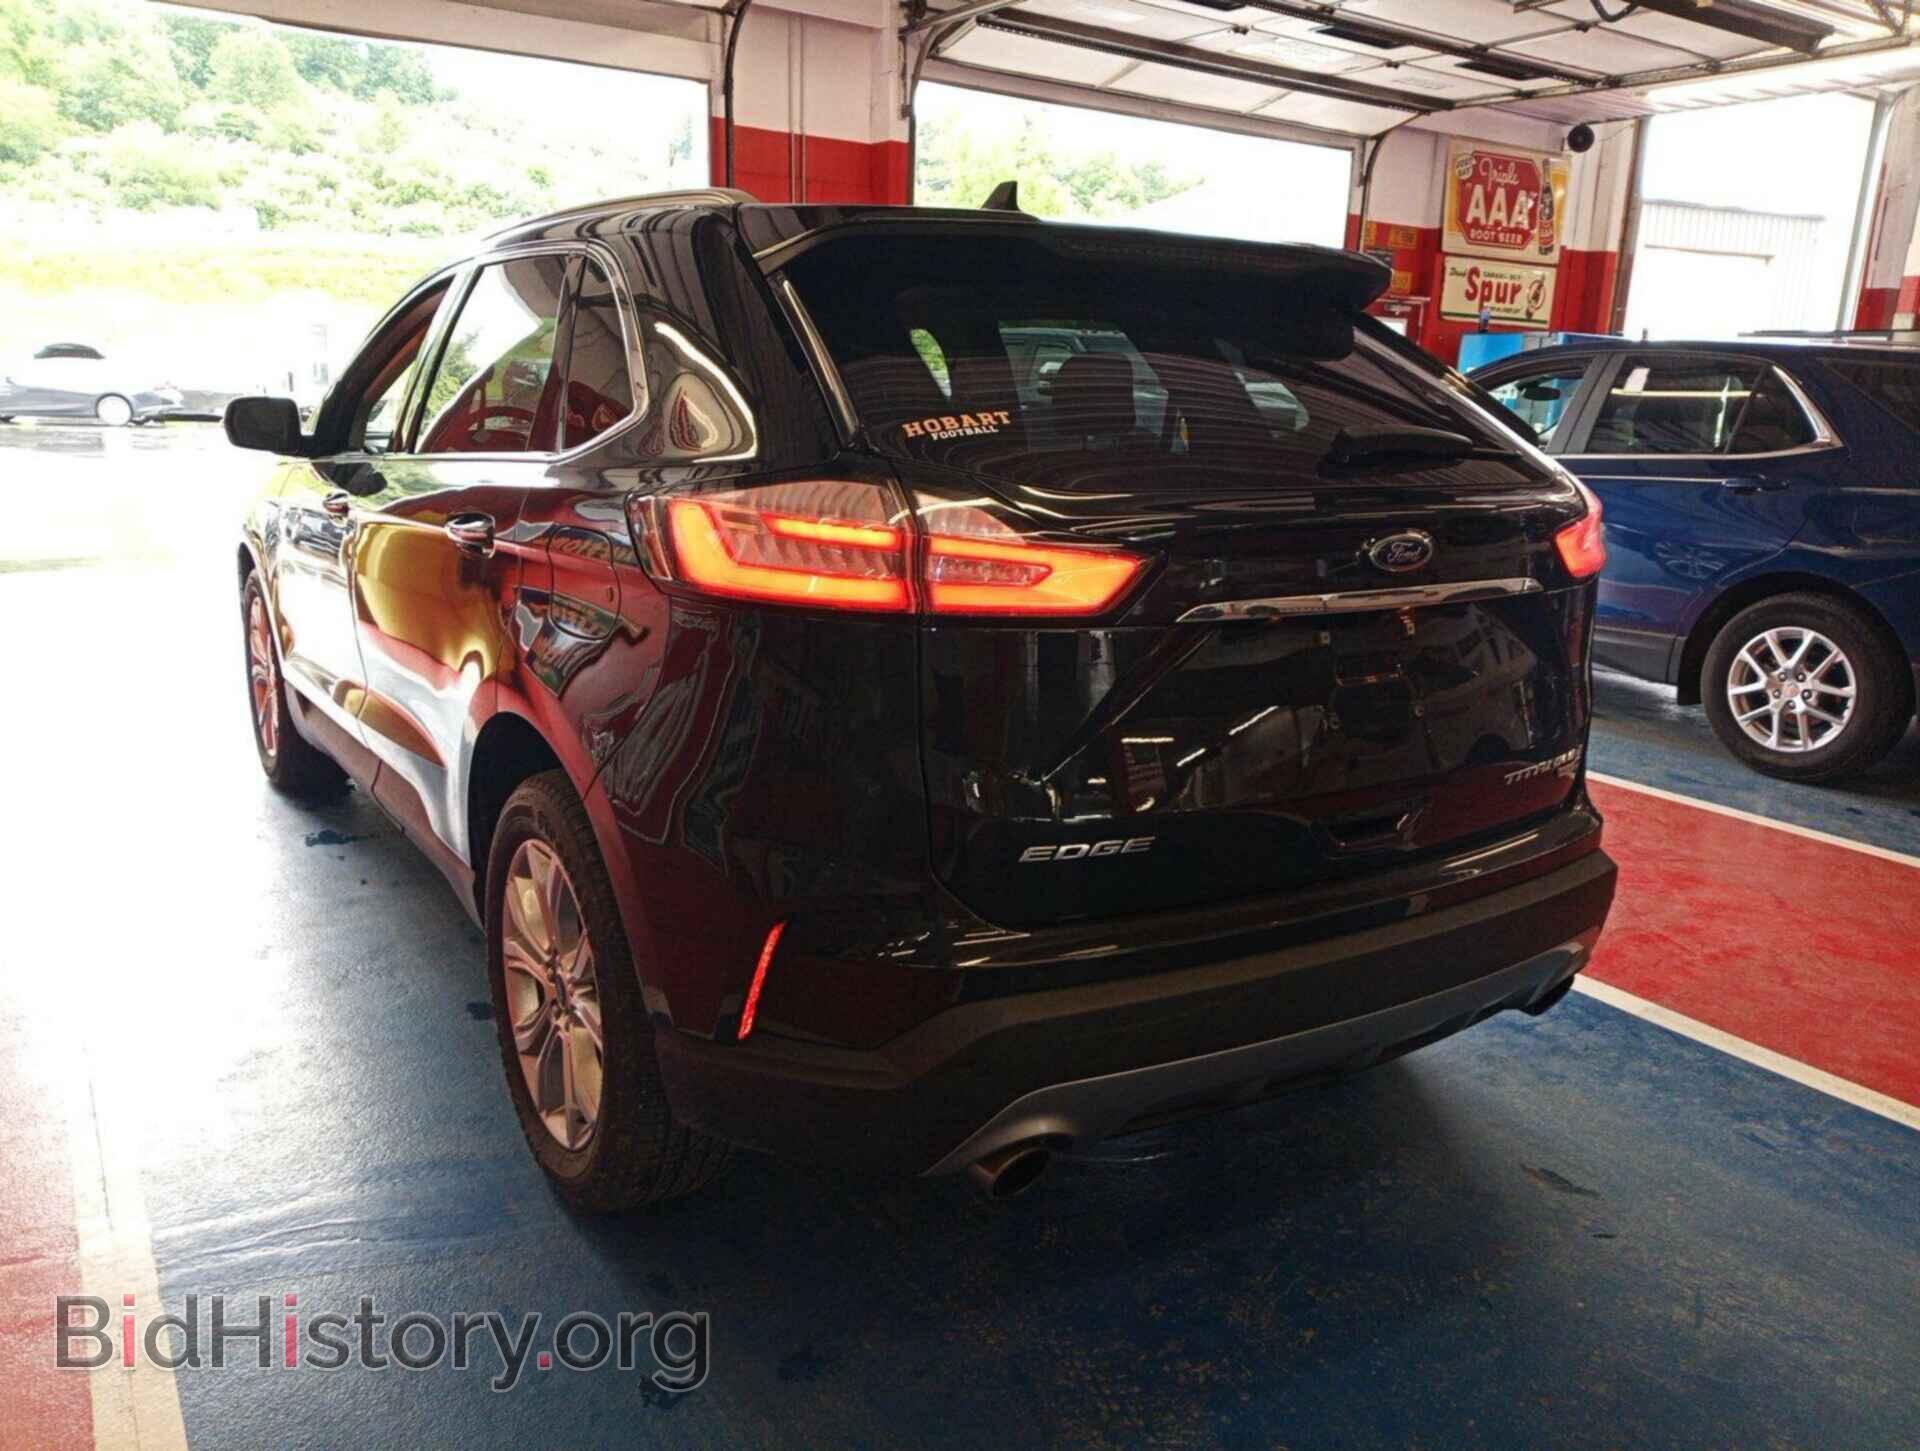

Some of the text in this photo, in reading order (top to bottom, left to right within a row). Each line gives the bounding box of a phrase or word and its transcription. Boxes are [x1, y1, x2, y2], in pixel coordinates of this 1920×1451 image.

[1479, 158, 1520, 193] Triple
[1470, 228, 1524, 244] ROOT BEER
[1465, 266, 1522, 312] Spur
[902, 411, 1011, 438] HOBART
[931, 425, 1000, 441] FOOTBALL
[1386, 541, 1422, 562] Ford
[1018, 836, 1156, 863] EDGE
